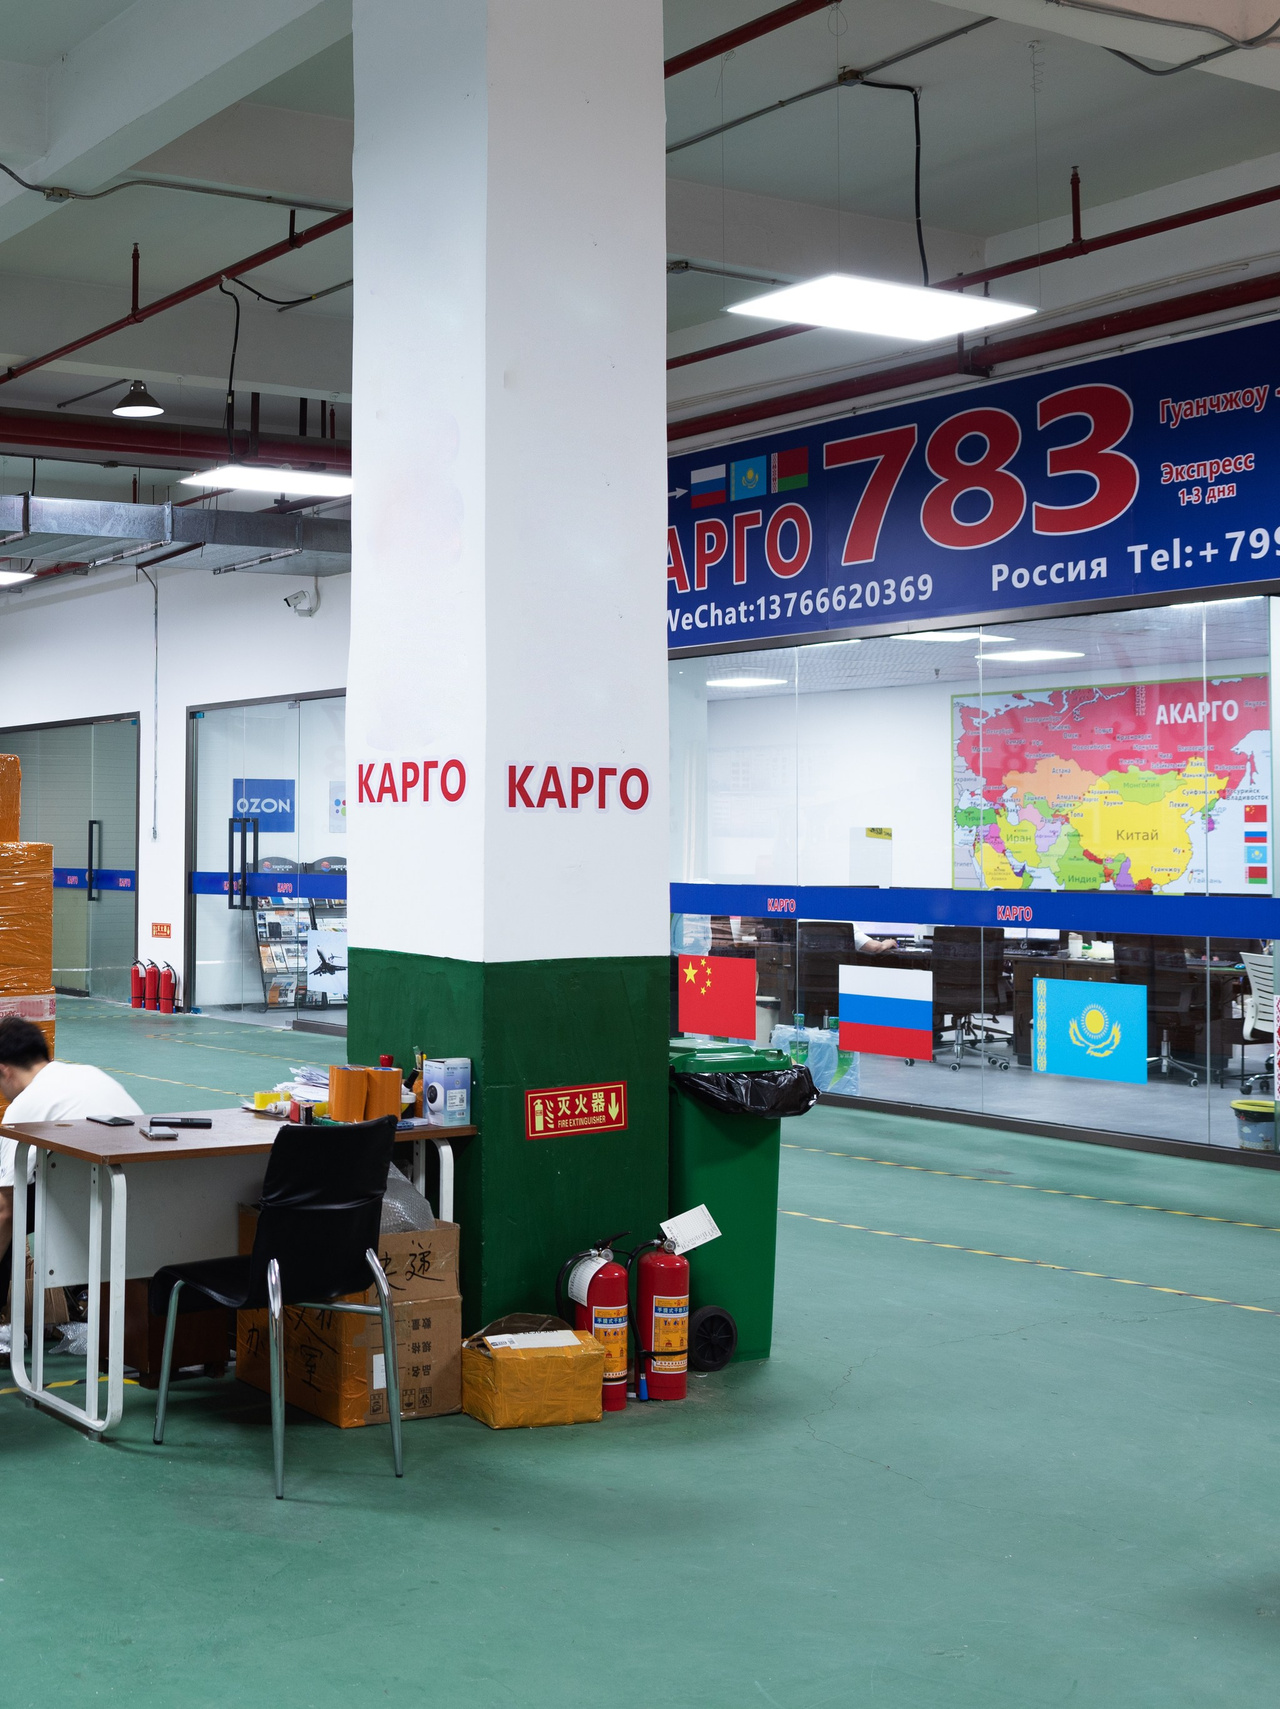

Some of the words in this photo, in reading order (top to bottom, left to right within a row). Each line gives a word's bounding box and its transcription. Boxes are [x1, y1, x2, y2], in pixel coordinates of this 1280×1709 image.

[1160, 385, 1270, 428] Гуанчжоу
[824, 383, 1140, 567] 783
[1161, 453, 1255, 484] Экспресс
[1179, 487, 1202, 506] 1-3
[1205, 483, 1236, 504] дня
[991, 556, 1107, 592] Россия
[1155, 699, 1239, 725] АКАРГО
[358, 758, 467, 803] КАРГО
[508, 765, 649, 811] КАРГО
[236, 797, 291, 814] OZON
[1006, 833, 1032, 844] Иран
[1116, 829, 1159, 841] Китай
[1068, 875, 1097, 884] Индия
[767, 898, 796, 914] КАРГО
[997, 905, 1033, 922] КАРГО
[557, 1091, 606, 1117] 灭火器
[558, 1119, 569, 1128] FIRE
[569, 1115, 607, 1128] EXTINGUISHER
